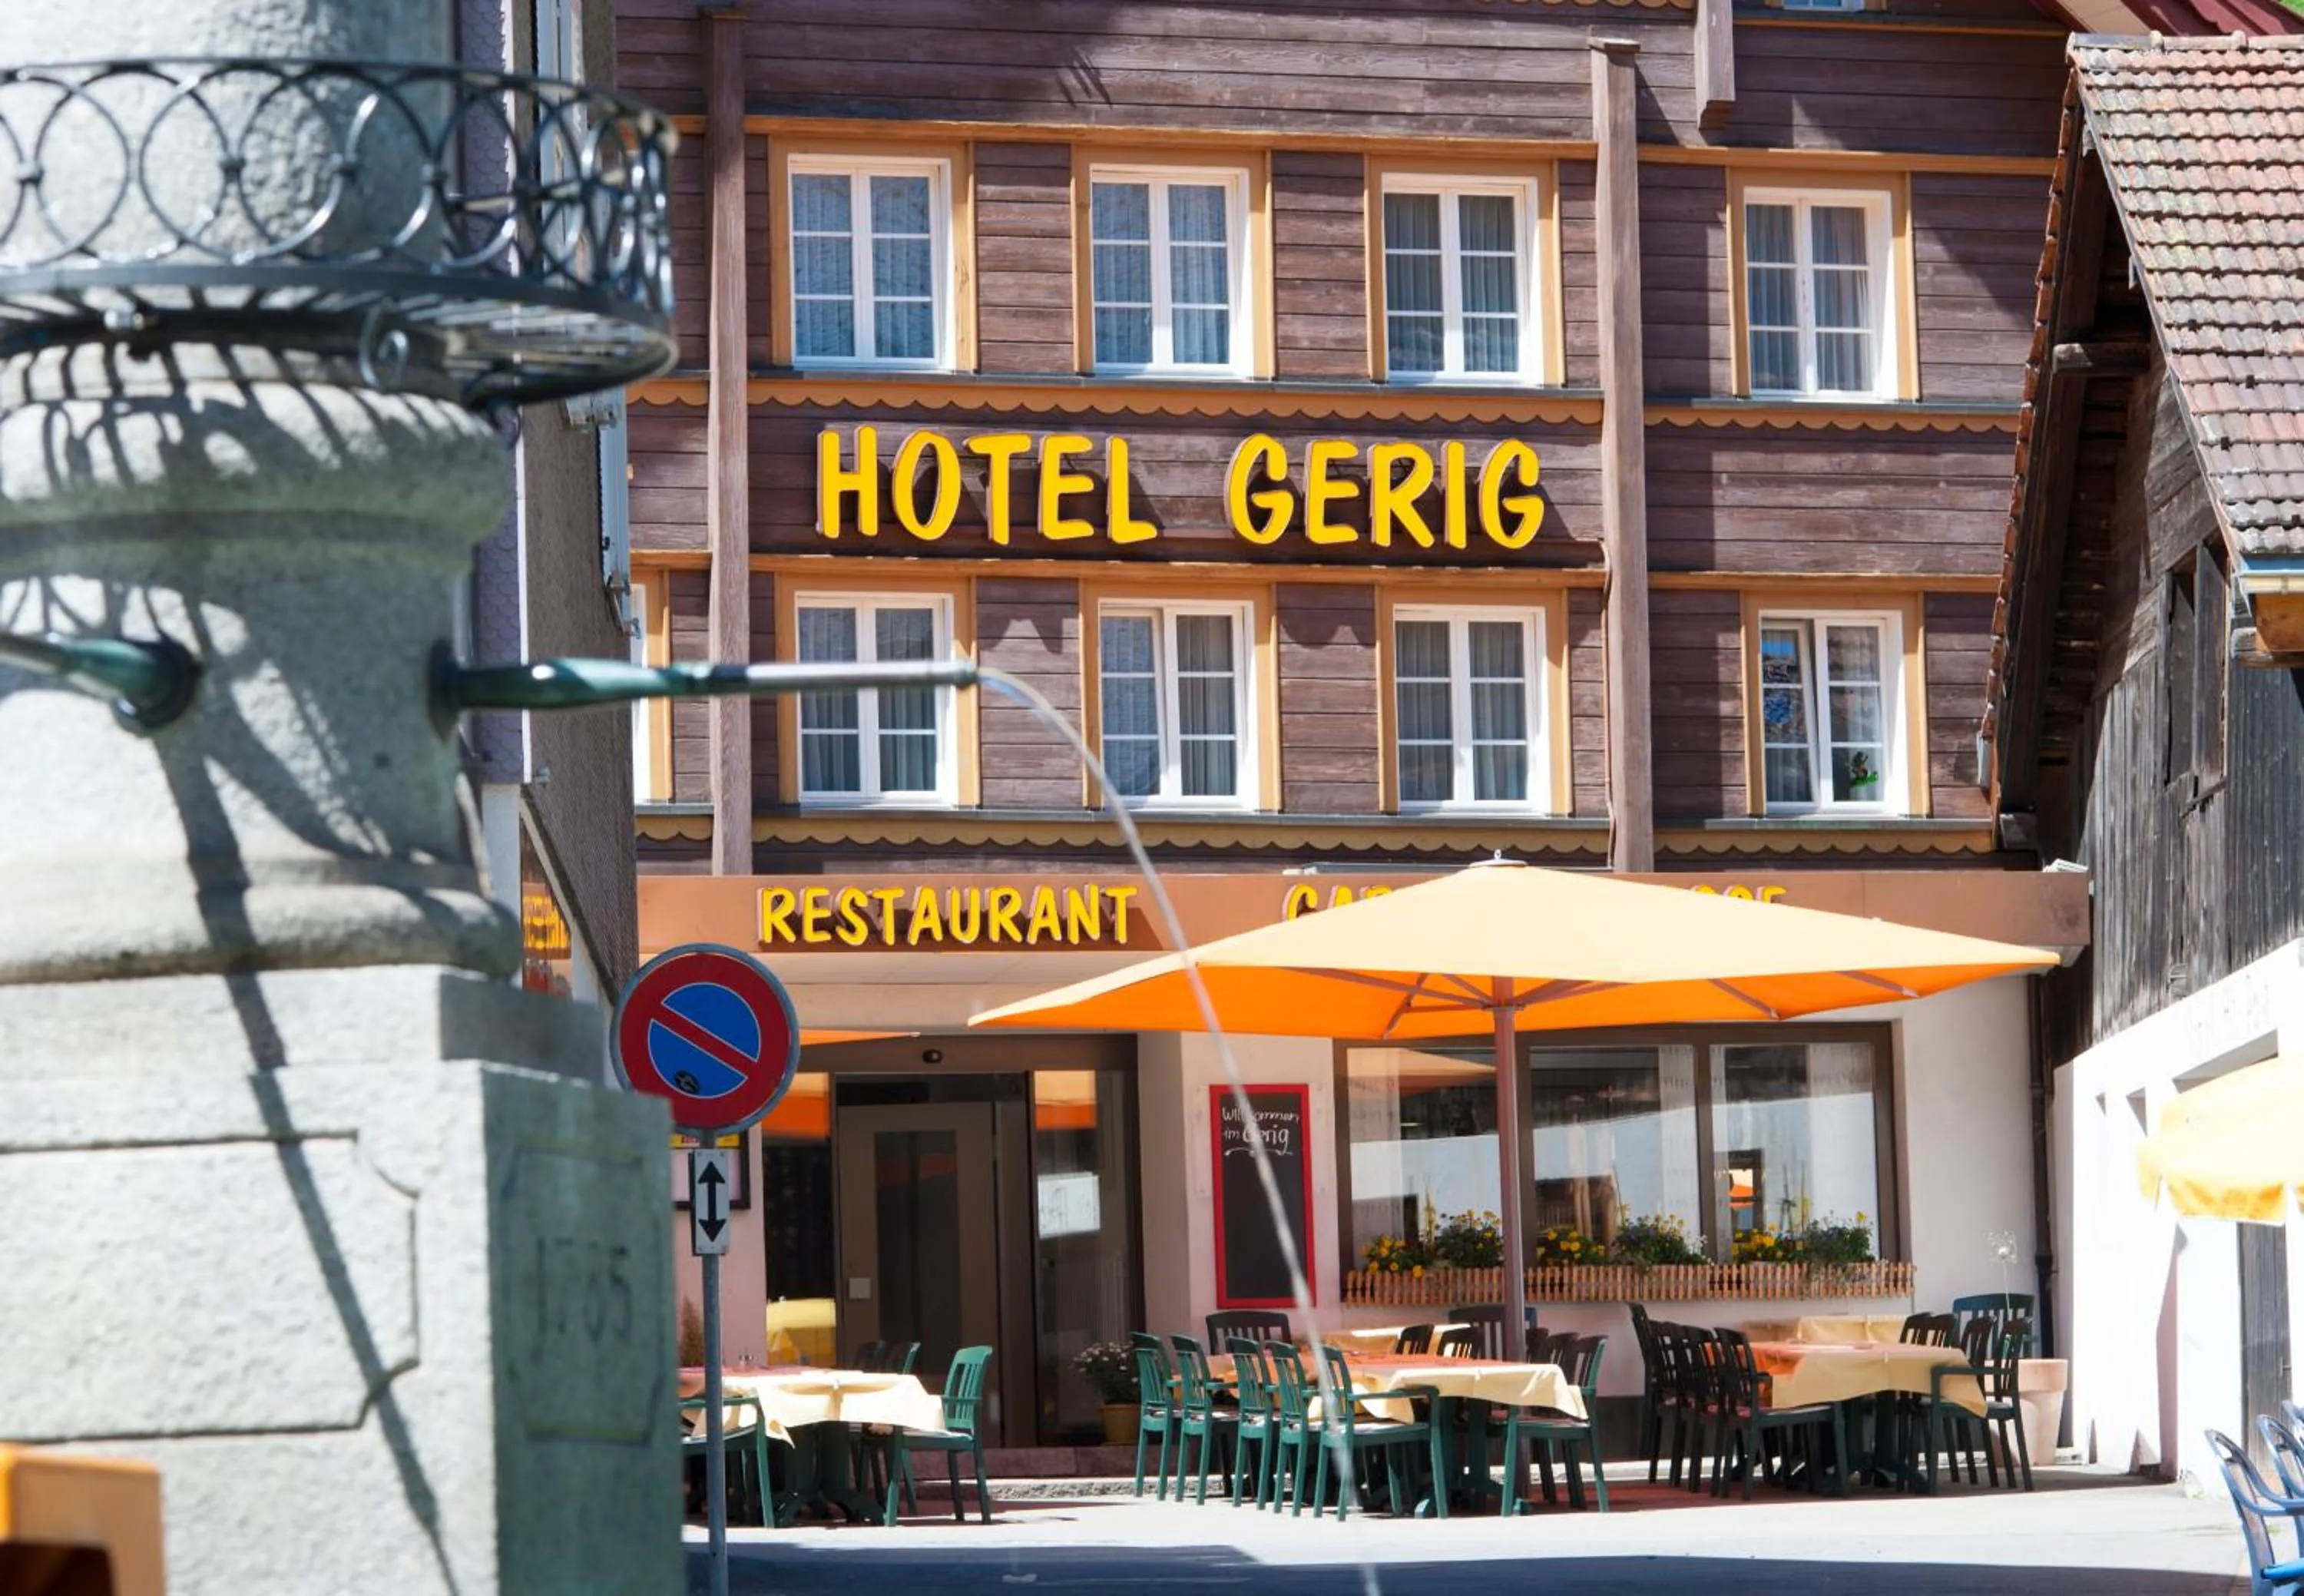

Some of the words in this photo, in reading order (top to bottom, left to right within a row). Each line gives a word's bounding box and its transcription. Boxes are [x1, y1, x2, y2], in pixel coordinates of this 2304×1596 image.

[816, 425, 1158, 546] HOTEL
[1224, 432, 1545, 550] GERIG
[758, 883, 1137, 945] RESTAURANT
